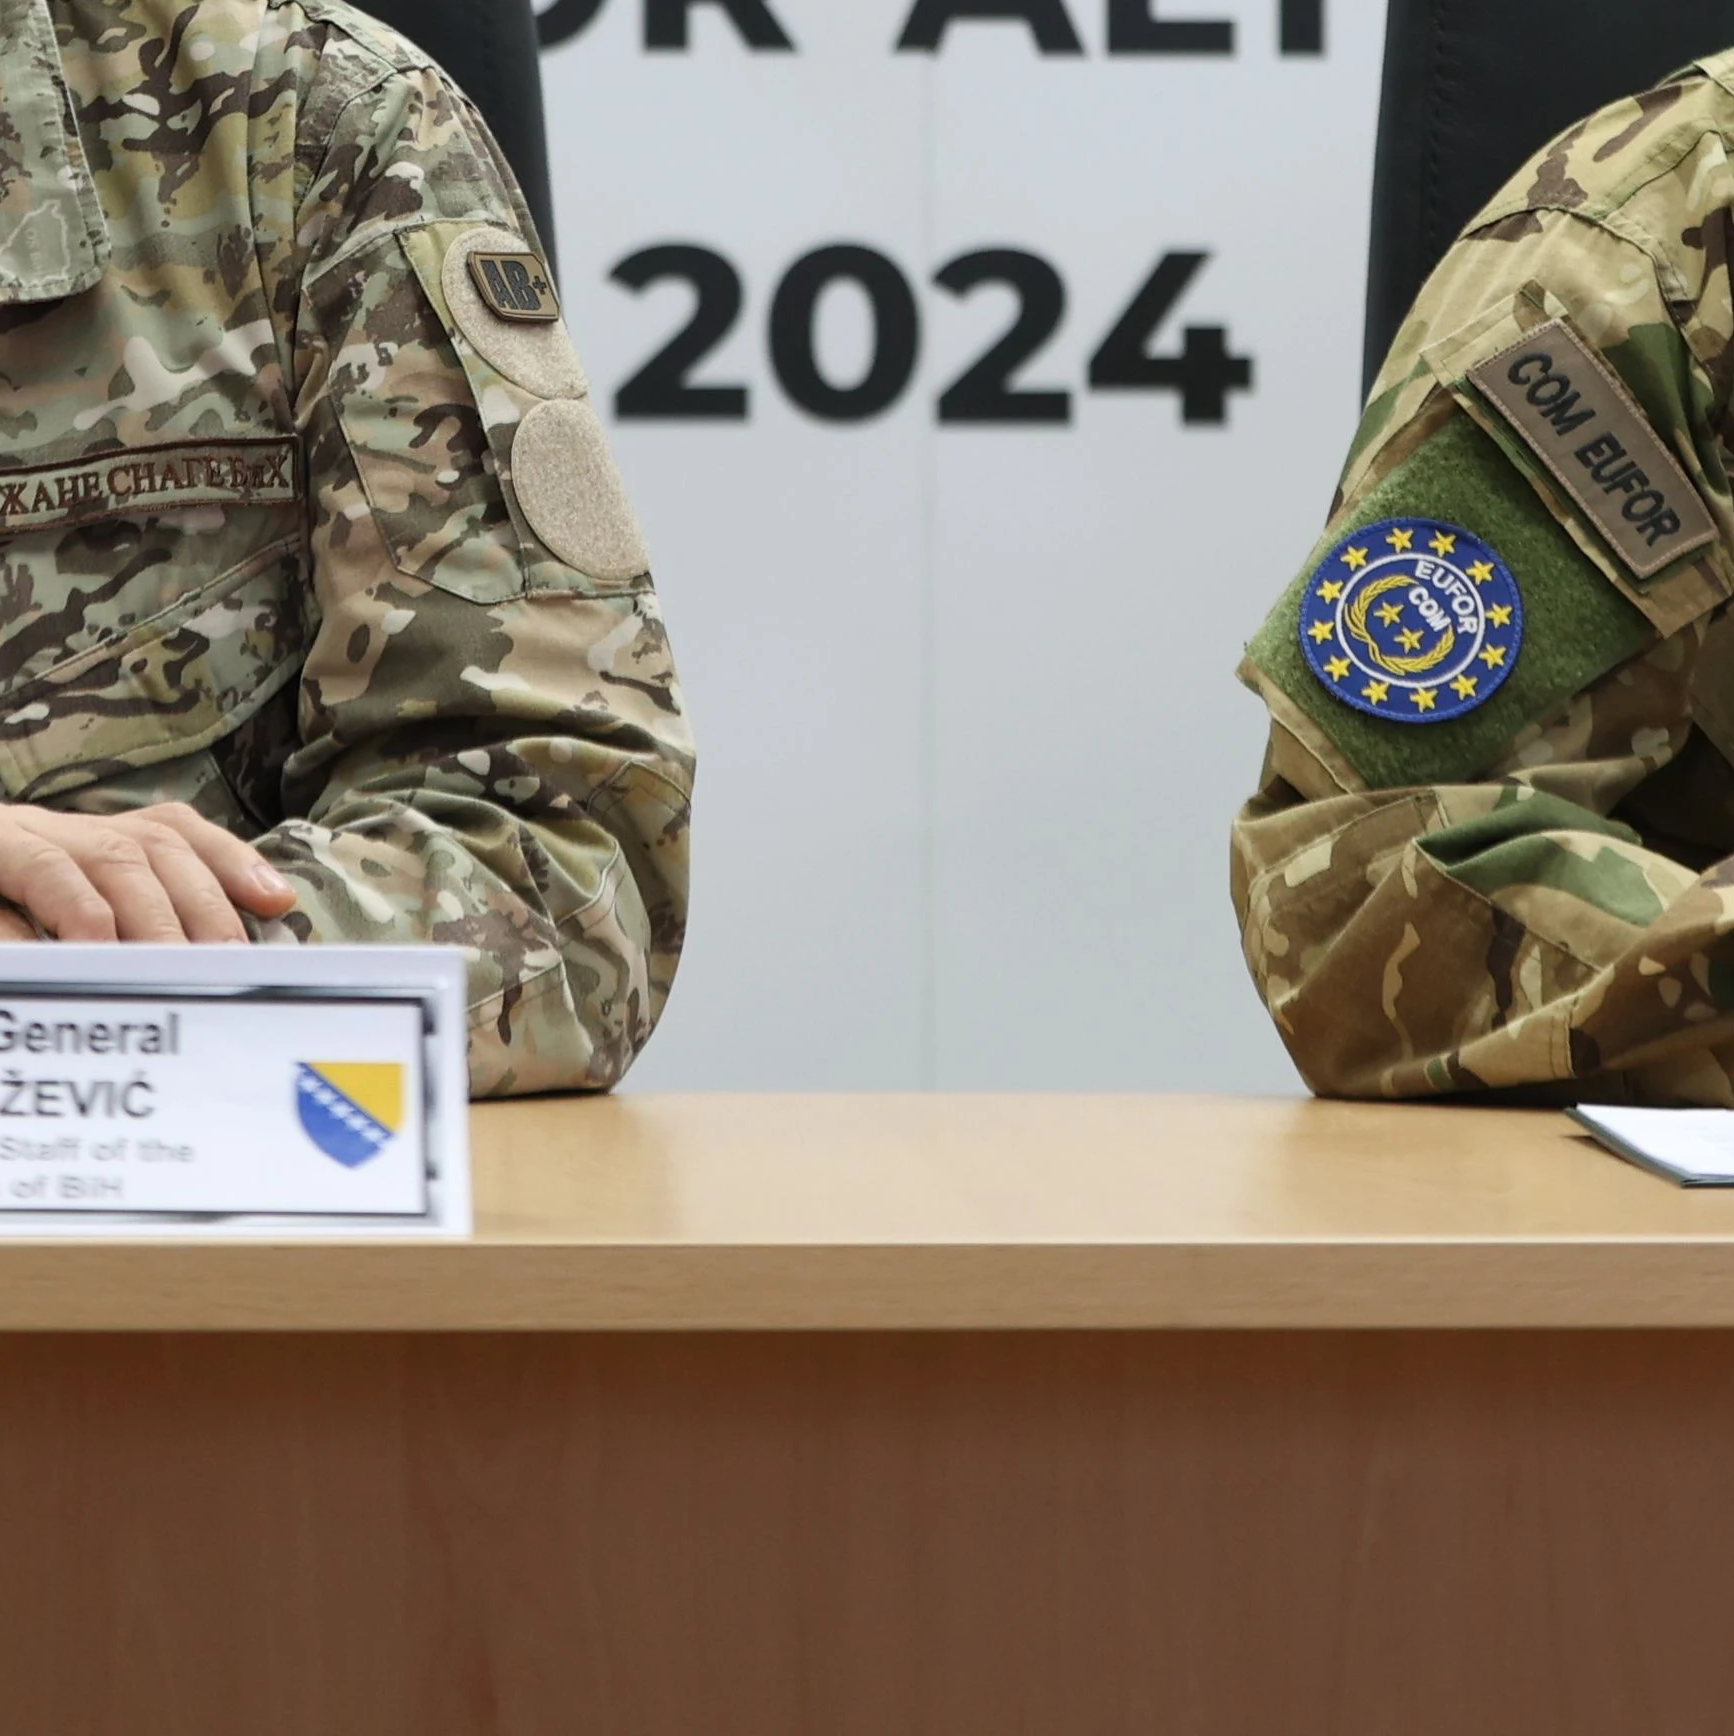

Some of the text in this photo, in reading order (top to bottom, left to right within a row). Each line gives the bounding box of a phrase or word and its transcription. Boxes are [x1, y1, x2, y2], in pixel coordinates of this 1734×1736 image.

[607, 241, 1252, 426] 2024
[1508, 352, 1682, 548] COM EUFOR
[1408, 586, 1452, 633] COM
[1415, 560, 1478, 635] EUFOR
[91, 1137, 128, 1164] of
[137, 1138, 195, 1164] the
[9, 1174, 49, 1202] of
